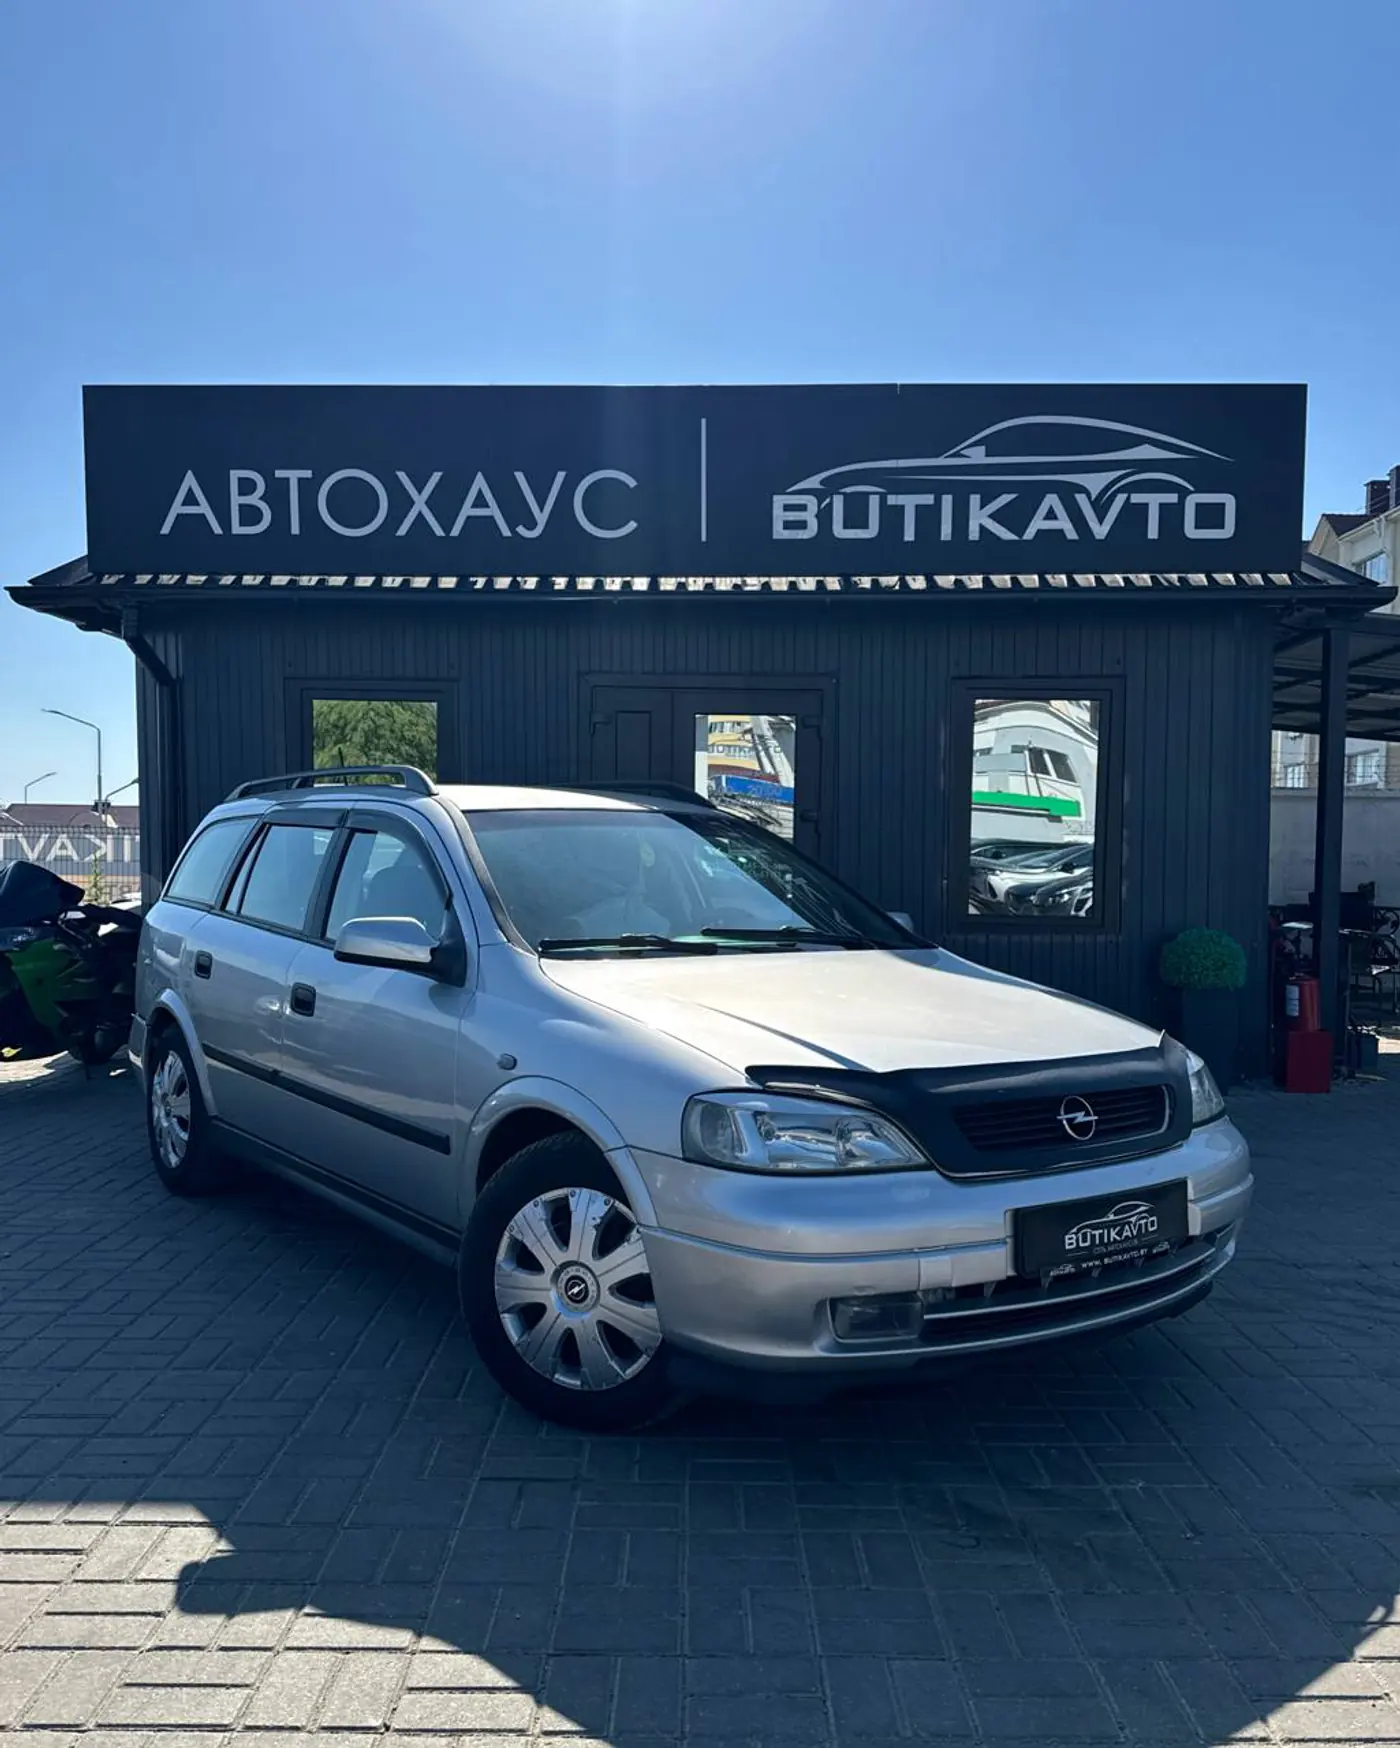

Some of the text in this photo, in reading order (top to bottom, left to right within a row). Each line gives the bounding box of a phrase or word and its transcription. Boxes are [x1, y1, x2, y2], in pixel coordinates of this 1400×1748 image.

[160, 468, 639, 539] АВТОХАУС
[772, 493, 1237, 541] BUTIKAVTO
[1065, 1216, 1158, 1250] BUTIKAVTO
